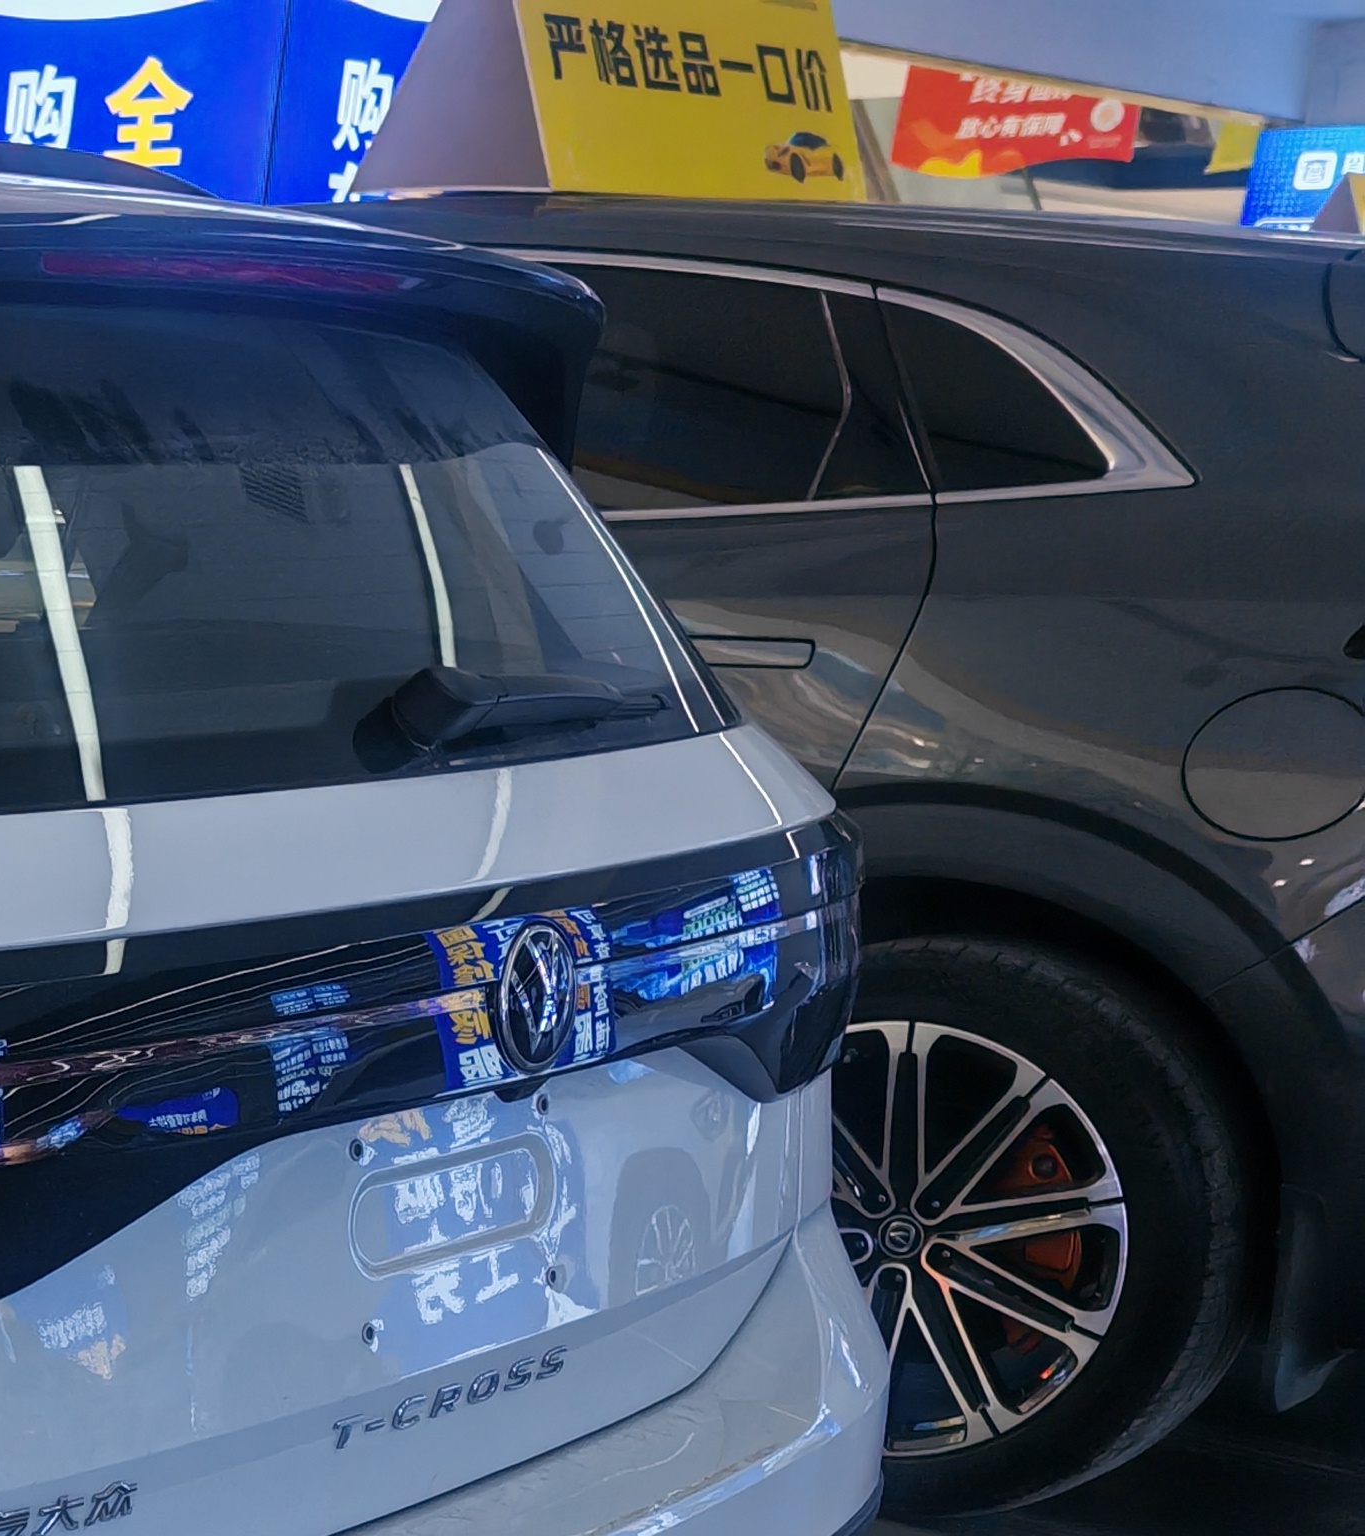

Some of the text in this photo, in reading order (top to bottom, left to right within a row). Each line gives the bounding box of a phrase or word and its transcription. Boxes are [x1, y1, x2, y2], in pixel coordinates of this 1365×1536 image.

[4, 64, 78, 150] 购
[103, 56, 194, 168] 全
[542, 12, 834, 114] 严格选品一口价
[332, 1344, 569, 1451] T-CROSS
